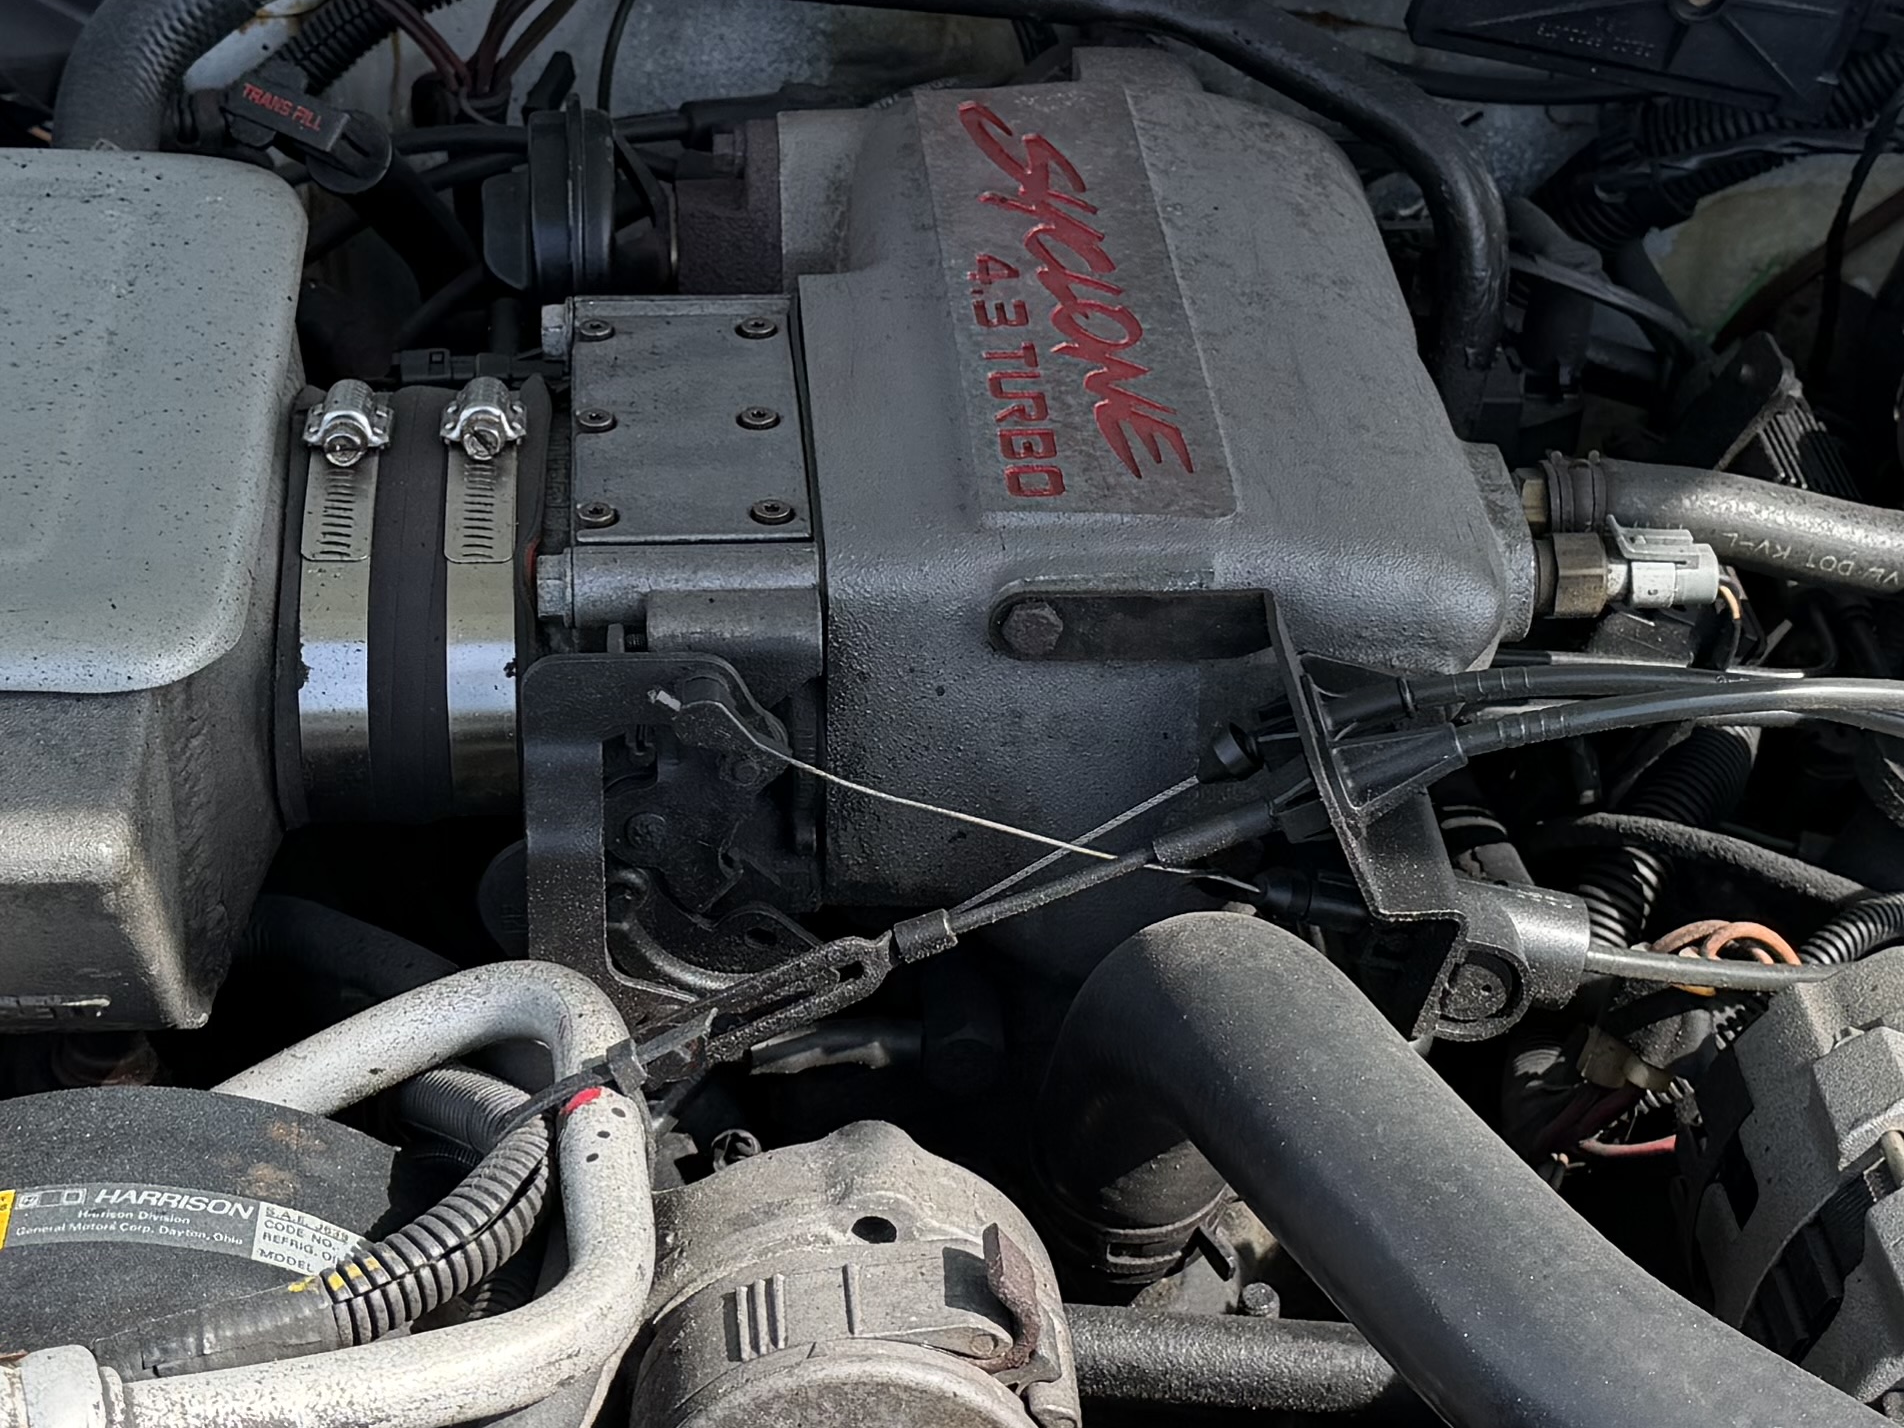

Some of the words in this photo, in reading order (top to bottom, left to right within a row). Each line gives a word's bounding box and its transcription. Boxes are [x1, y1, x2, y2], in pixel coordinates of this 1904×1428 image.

[241, 82, 294, 117] TRANS
[983, 342, 1065, 497] TURBO
[1805, 553, 1853, 574] DOT
[93, 1187, 254, 1219] HARRISON
[78, 1209, 133, 1219] Harrison
[137, 1210, 190, 1225] Division
[264, 1219, 305, 1238] CODE
[16, 1222, 65, 1236] General
[69, 1221, 116, 1231] Motors
[119, 1222, 153, 1235] Corp.
[158, 1225, 209, 1241] Dayton,
[212, 1232, 243, 1245] Ohio
[262, 1232, 319, 1258] REFRIG.
[258, 1248, 315, 1273] MODEL
